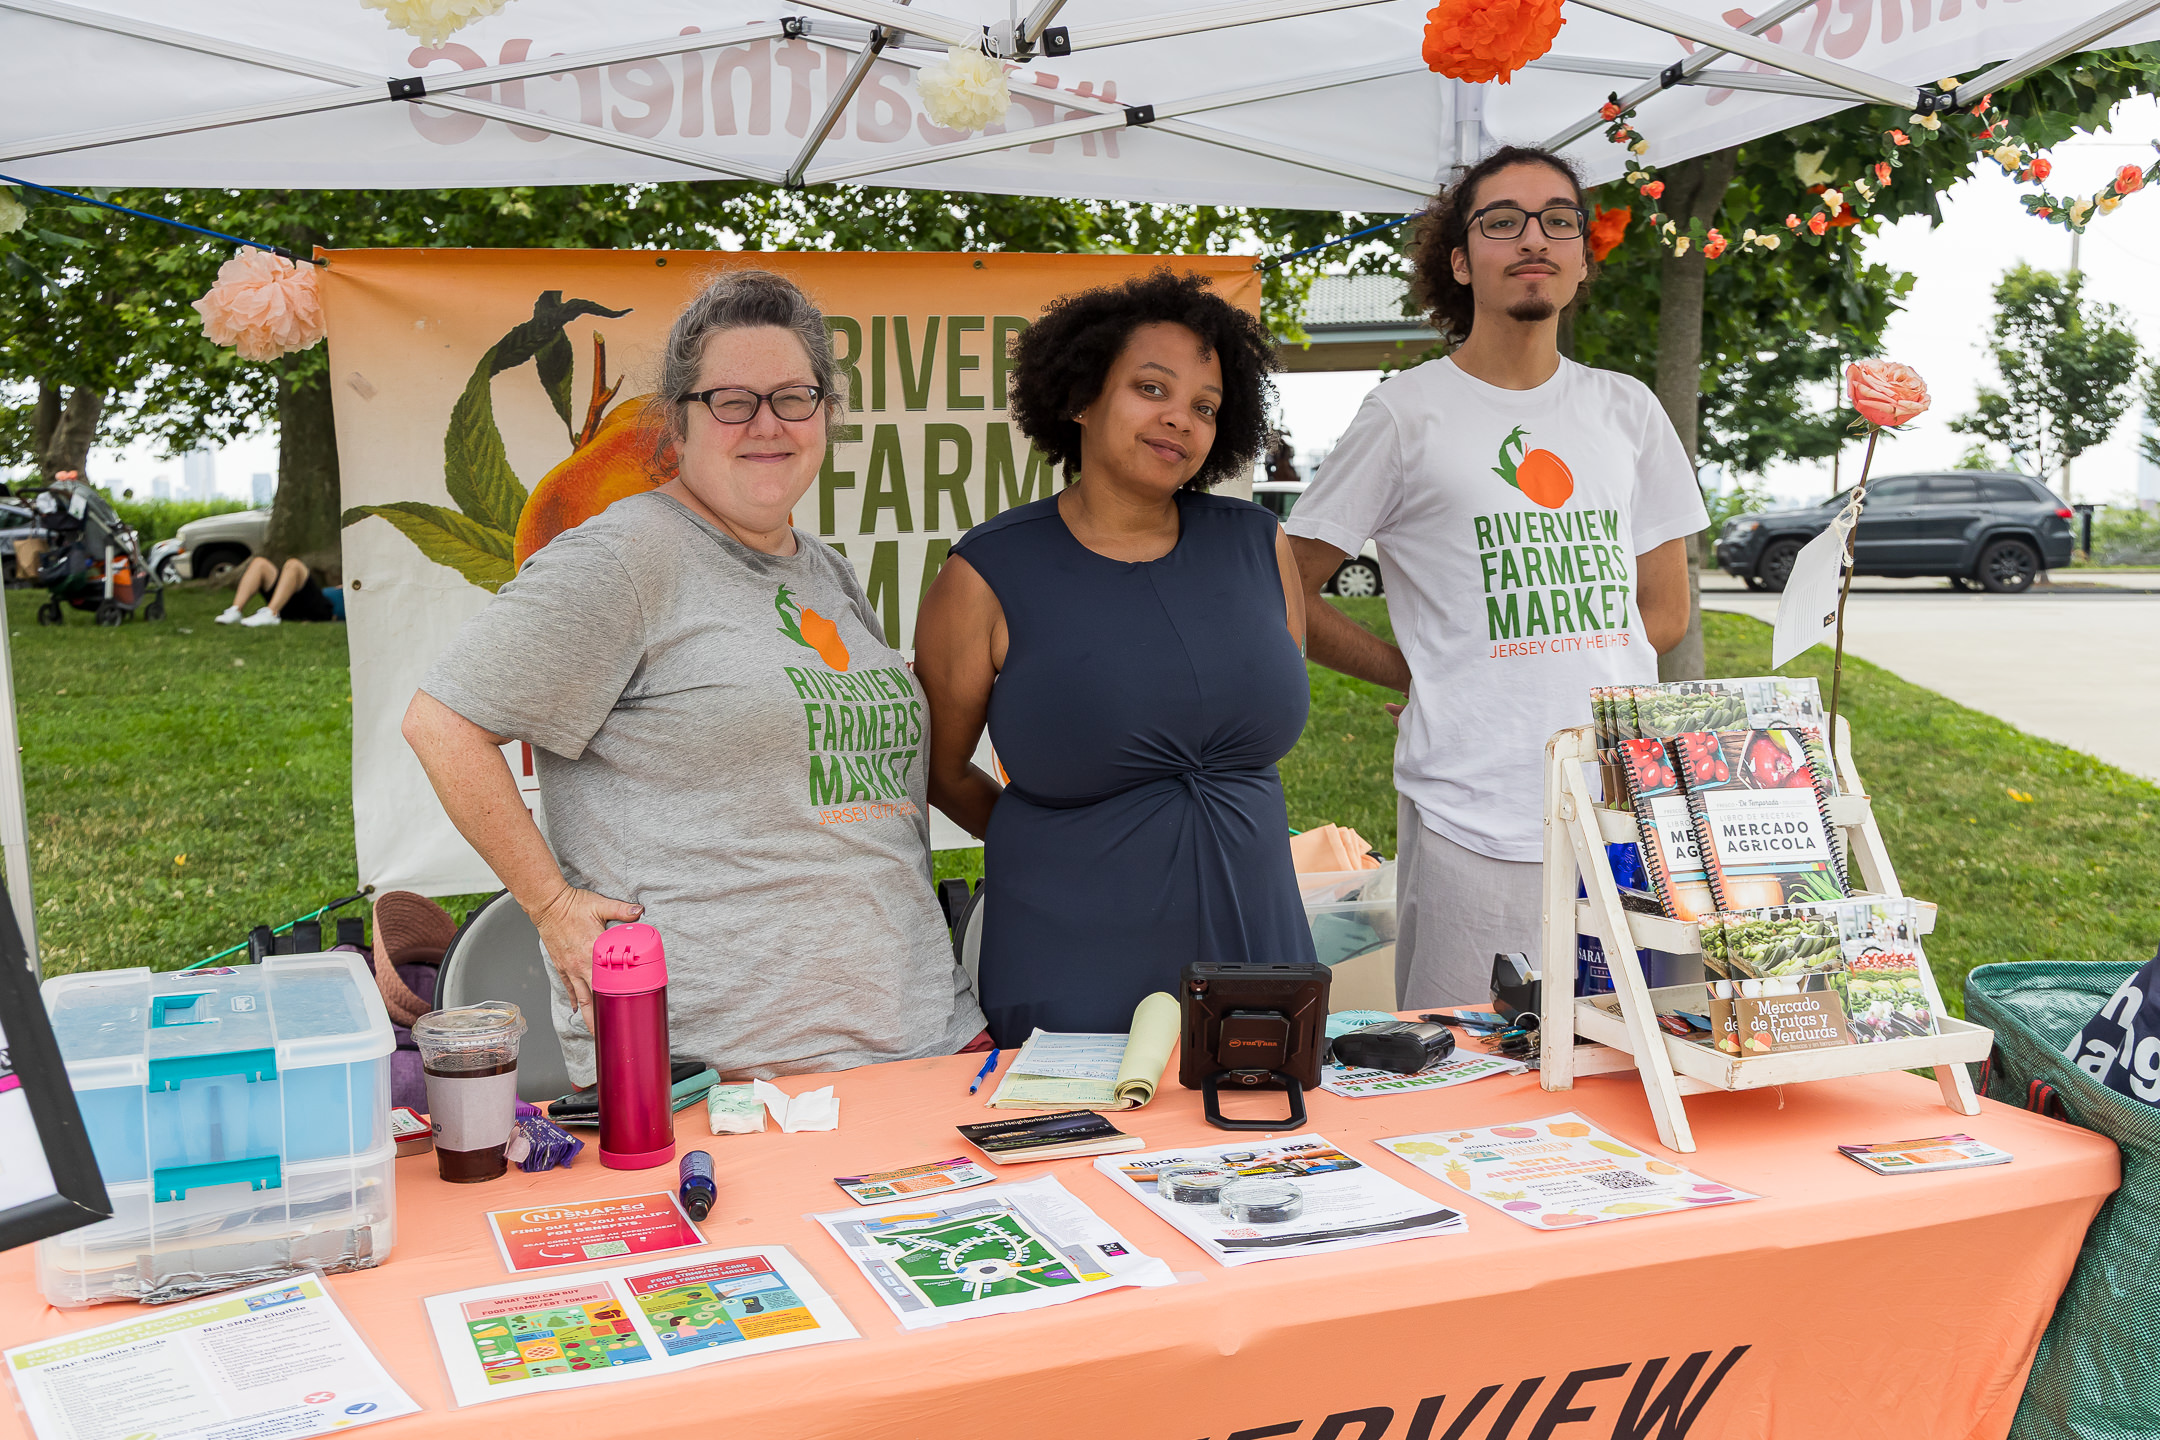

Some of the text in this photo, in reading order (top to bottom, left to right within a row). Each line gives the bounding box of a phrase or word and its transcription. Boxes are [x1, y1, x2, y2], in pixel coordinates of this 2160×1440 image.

[1473, 509, 1618, 550] RIVERVIEW
[1480, 544, 1628, 593] FARMERS
[1486, 585, 1630, 640] MARKET
[1489, 640, 1546, 659] JERSEY
[1550, 637, 1582, 653] CITY
[783, 666, 914, 702] RIVERVIEW
[804, 700, 922, 751] FARMERS
[809, 749, 918, 806] MARKET
[818, 806, 869, 826] JERSEY
[870, 803, 899, 820] CITY
[1719, 812, 1796, 822] LIBRO DE RECETAS
[1722, 821, 1809, 837] MERCADO
[1727, 836, 1816, 853] AGRICOLA
[1757, 997, 1820, 1016] Mercado
[1750, 1013, 1828, 1031] de Frutas y
[1771, 1027, 1838, 1043] Verduras
[1441, 1059, 1485, 1073] GOOD
[1446, 1061, 1506, 1079] USE
[1371, 1076, 1448, 1091] SNAP
[971, 1111, 1091, 1131] Riverview Neighborhood Association
[1464, 1142, 1506, 1150] DONATE
[1129, 1156, 1185, 1169] njpac
[1486, 1158, 1615, 1179] ANNIVERSARY
[1508, 1156, 1571, 1167] 15TH
[1502, 1165, 1622, 1183] FUNDRAISER
[510, 1227, 542, 1236] FIND
[545, 1222, 570, 1231] OUT
[617, 1210, 671, 1221] QUALIFY
[575, 1221, 642, 1233] BENEFITS.
[621, 1223, 677, 1235] APPOINTMENT
[580, 1236, 620, 1244] BENEFITS
[650, 1275, 673, 1283] FOOD
[674, 1266, 723, 1278] STAMP/EBT
[679, 1271, 720, 1283] FARMERS
[721, 1266, 756, 1275] MARKET
[494, 1297, 520, 1305] WHAT
[508, 1300, 560, 1312] STAMP/EBT
[564, 1294, 599, 1303] TOKENS
[203, 1325, 224, 1334] Not
[131, 1339, 167, 1351] Foods
